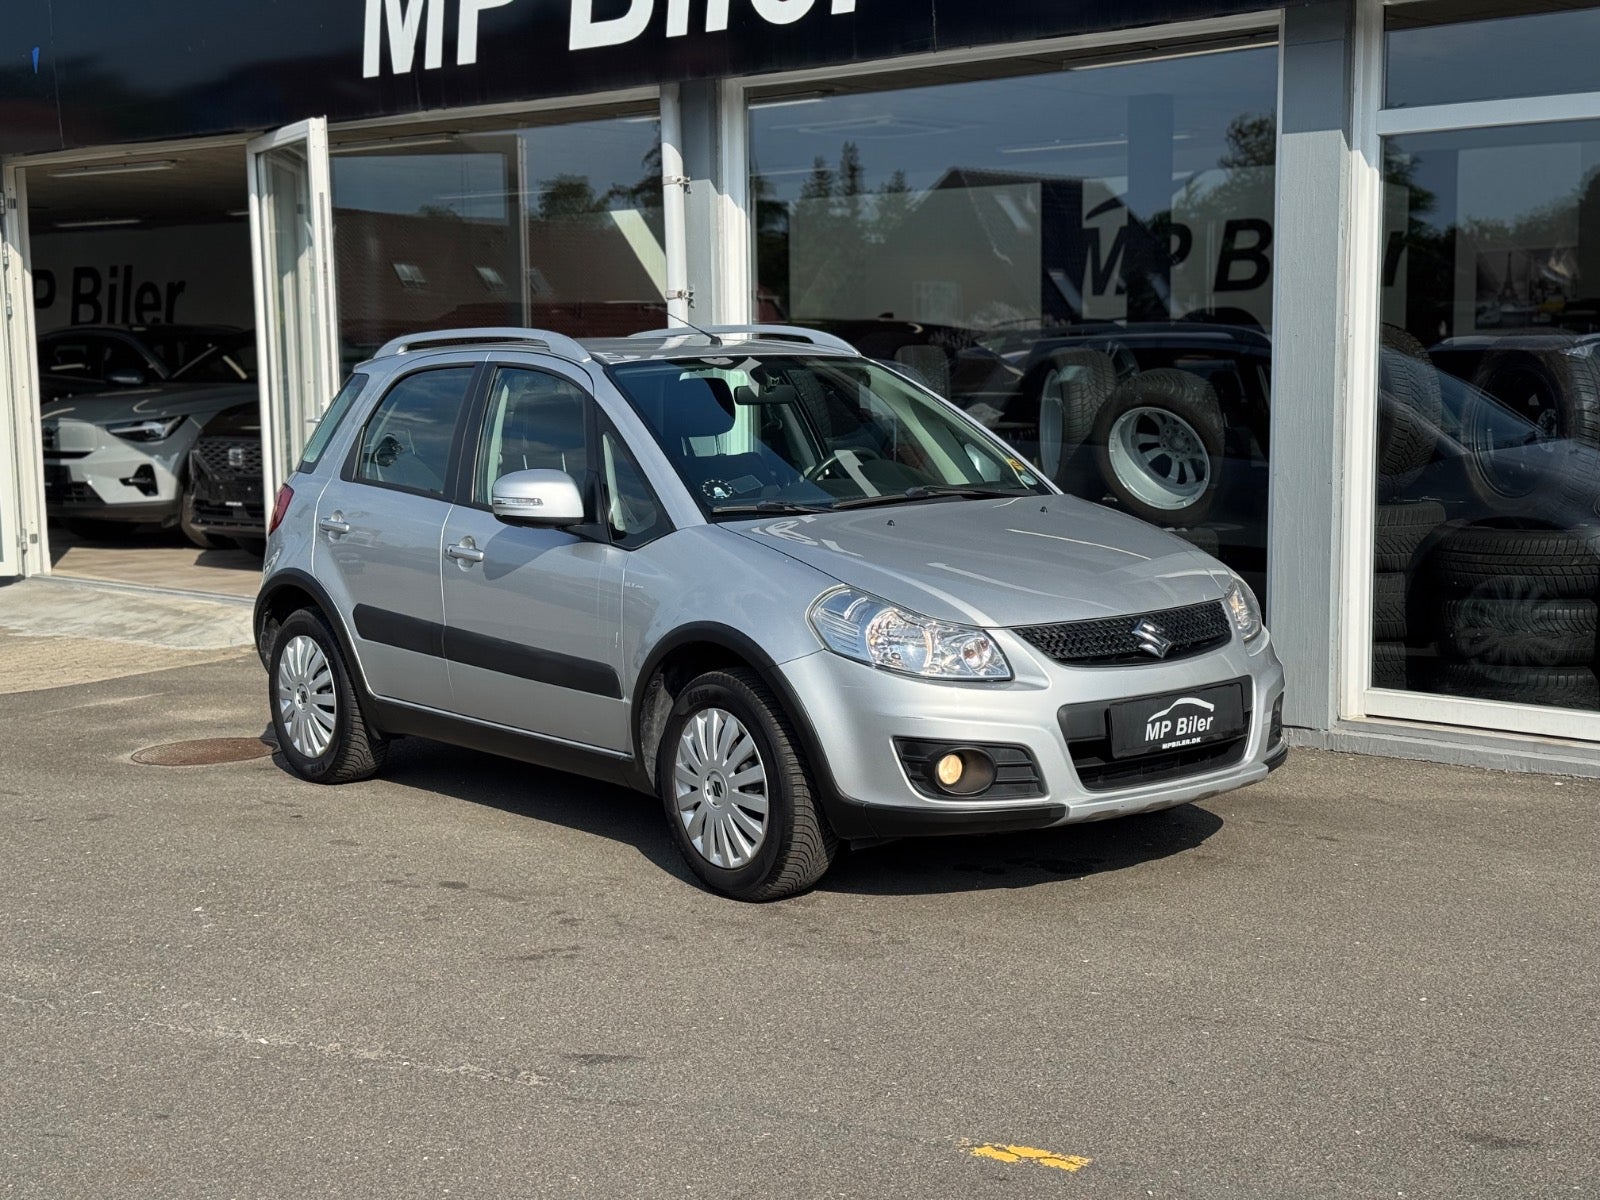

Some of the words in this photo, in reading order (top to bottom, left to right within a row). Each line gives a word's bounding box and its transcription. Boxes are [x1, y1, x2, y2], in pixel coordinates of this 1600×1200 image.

[71, 265, 186, 325] Biler
[1145, 720, 1171, 741] MP
[1176, 715, 1213, 736] Biler
[1162, 736, 1201, 749] MPBILER.DK
